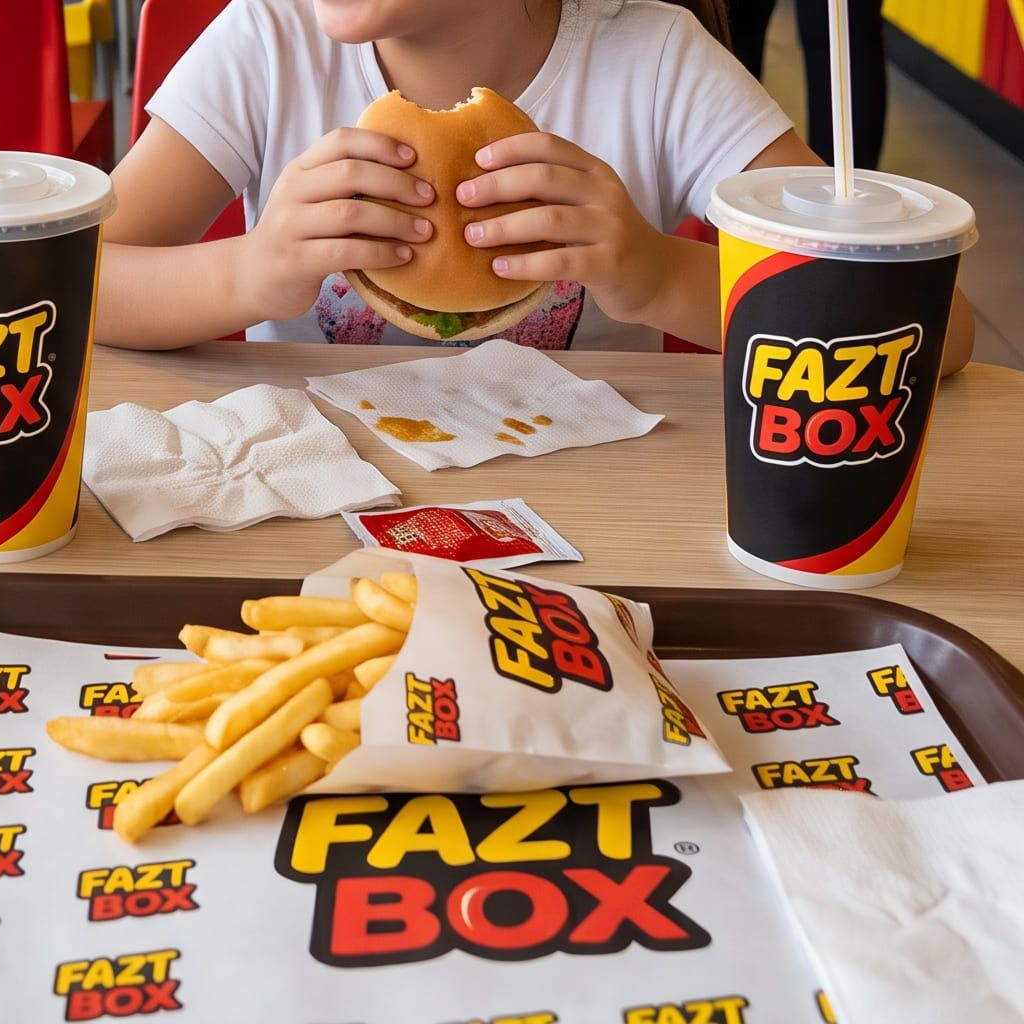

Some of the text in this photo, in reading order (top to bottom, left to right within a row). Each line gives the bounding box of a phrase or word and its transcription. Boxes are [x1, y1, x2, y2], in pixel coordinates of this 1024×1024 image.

[750, 335, 914, 403] FAZT
[759, 398, 903, 455] BOX
[465, 568, 555, 688] FAZT
[521, 582, 606, 686] BOX
[405, 673, 437, 745] FAZT
[431, 678, 460, 742] BOX
[719, 682, 817, 714] FAZT
[742, 704, 839, 733] BOX
[755, 756, 858, 789] FAZT
[291, 783, 662, 874] FAZT
[79, 859, 195, 898] FAZT
[91, 884, 199, 921] BOX
[330, 865, 689, 957] BOX
[55, 949, 180, 995] FAZT
[67, 979, 183, 1021] BOX
